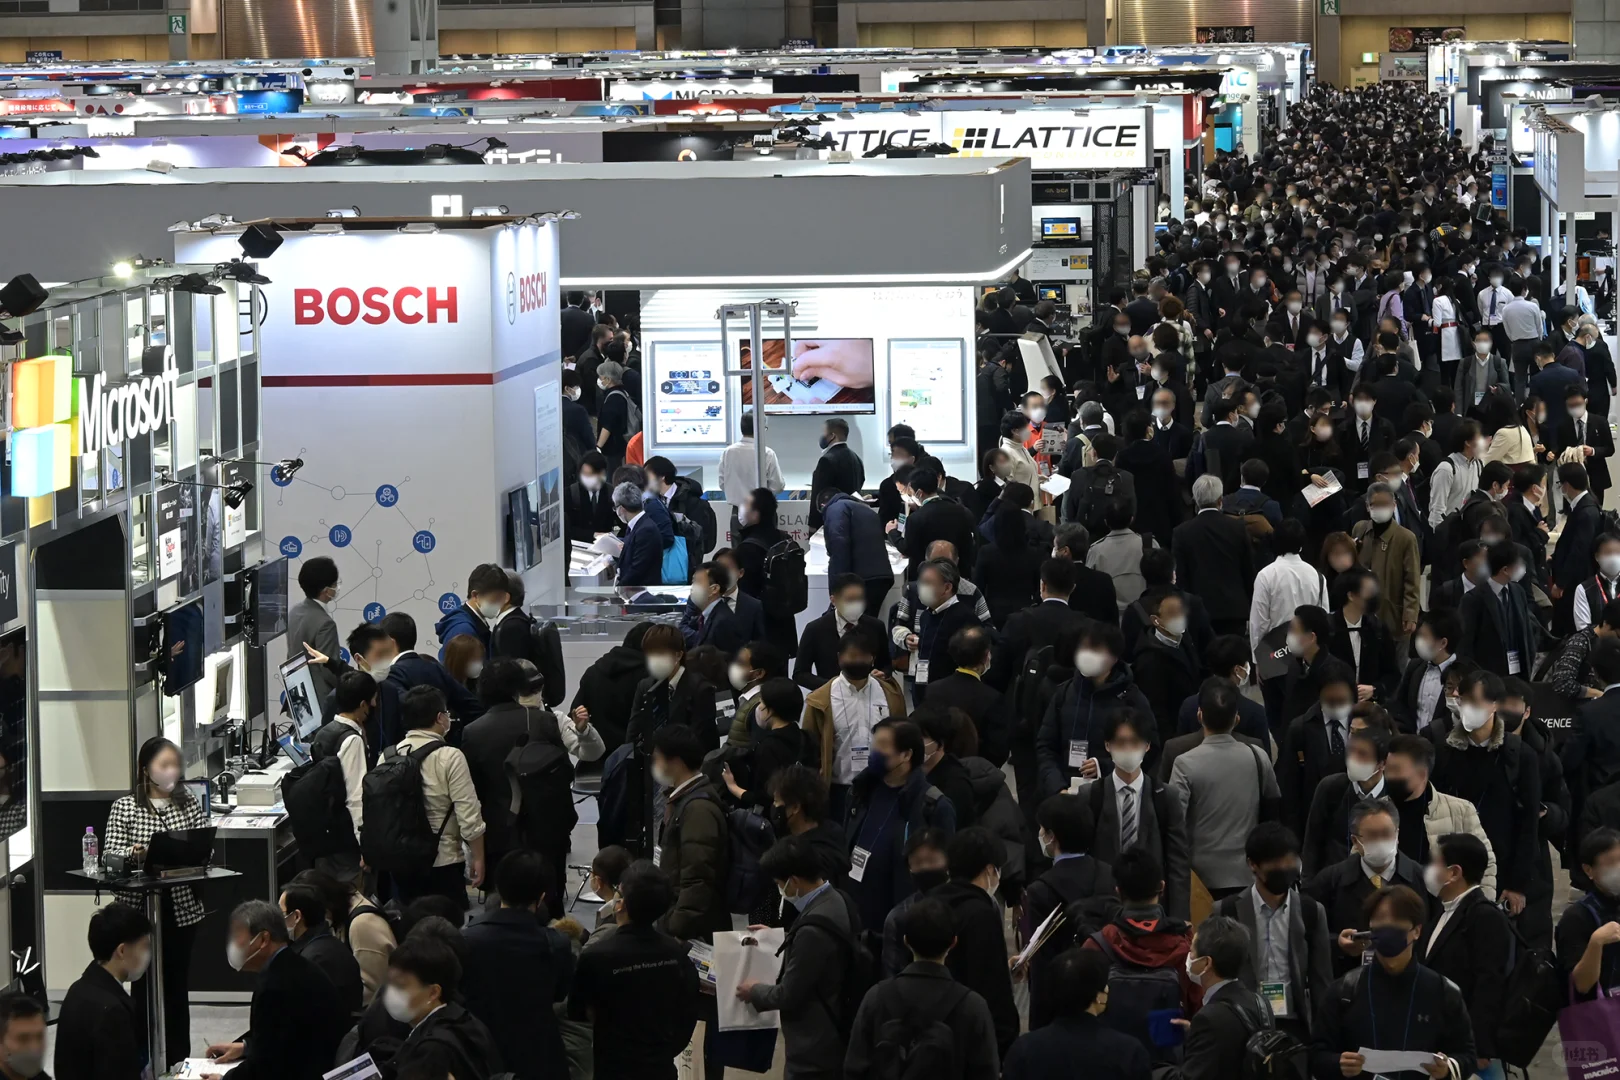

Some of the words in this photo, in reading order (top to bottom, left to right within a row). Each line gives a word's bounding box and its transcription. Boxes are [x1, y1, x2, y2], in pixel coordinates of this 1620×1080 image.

[993, 125, 1141, 149] LATTICE
[294, 286, 458, 325] BOSCH
[519, 271, 547, 313] BOSCH
[78, 344, 179, 453] Microsoft
[1538, 717, 1572, 728] YENCE
